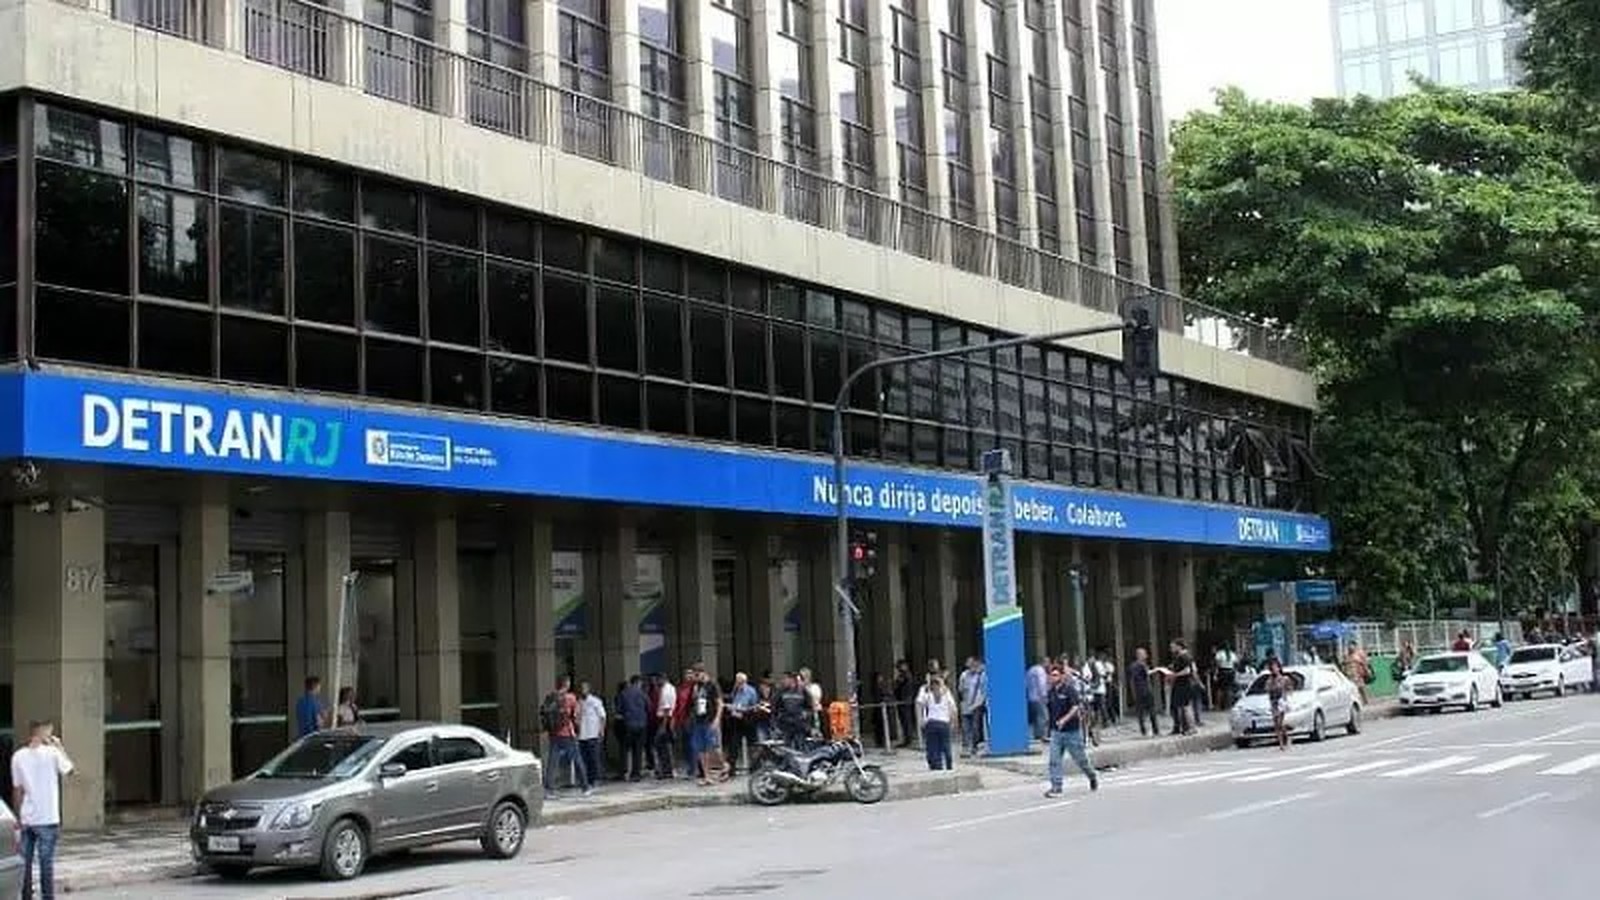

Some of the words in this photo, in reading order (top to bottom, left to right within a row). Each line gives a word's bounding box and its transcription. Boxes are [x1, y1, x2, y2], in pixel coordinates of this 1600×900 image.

[812, 475, 873, 507] Nunca
[879, 482, 926, 516] dirija
[930, 487, 984, 520] depois
[1013, 495, 1059, 523] beber.
[1066, 501, 1127, 528] Colabore.
